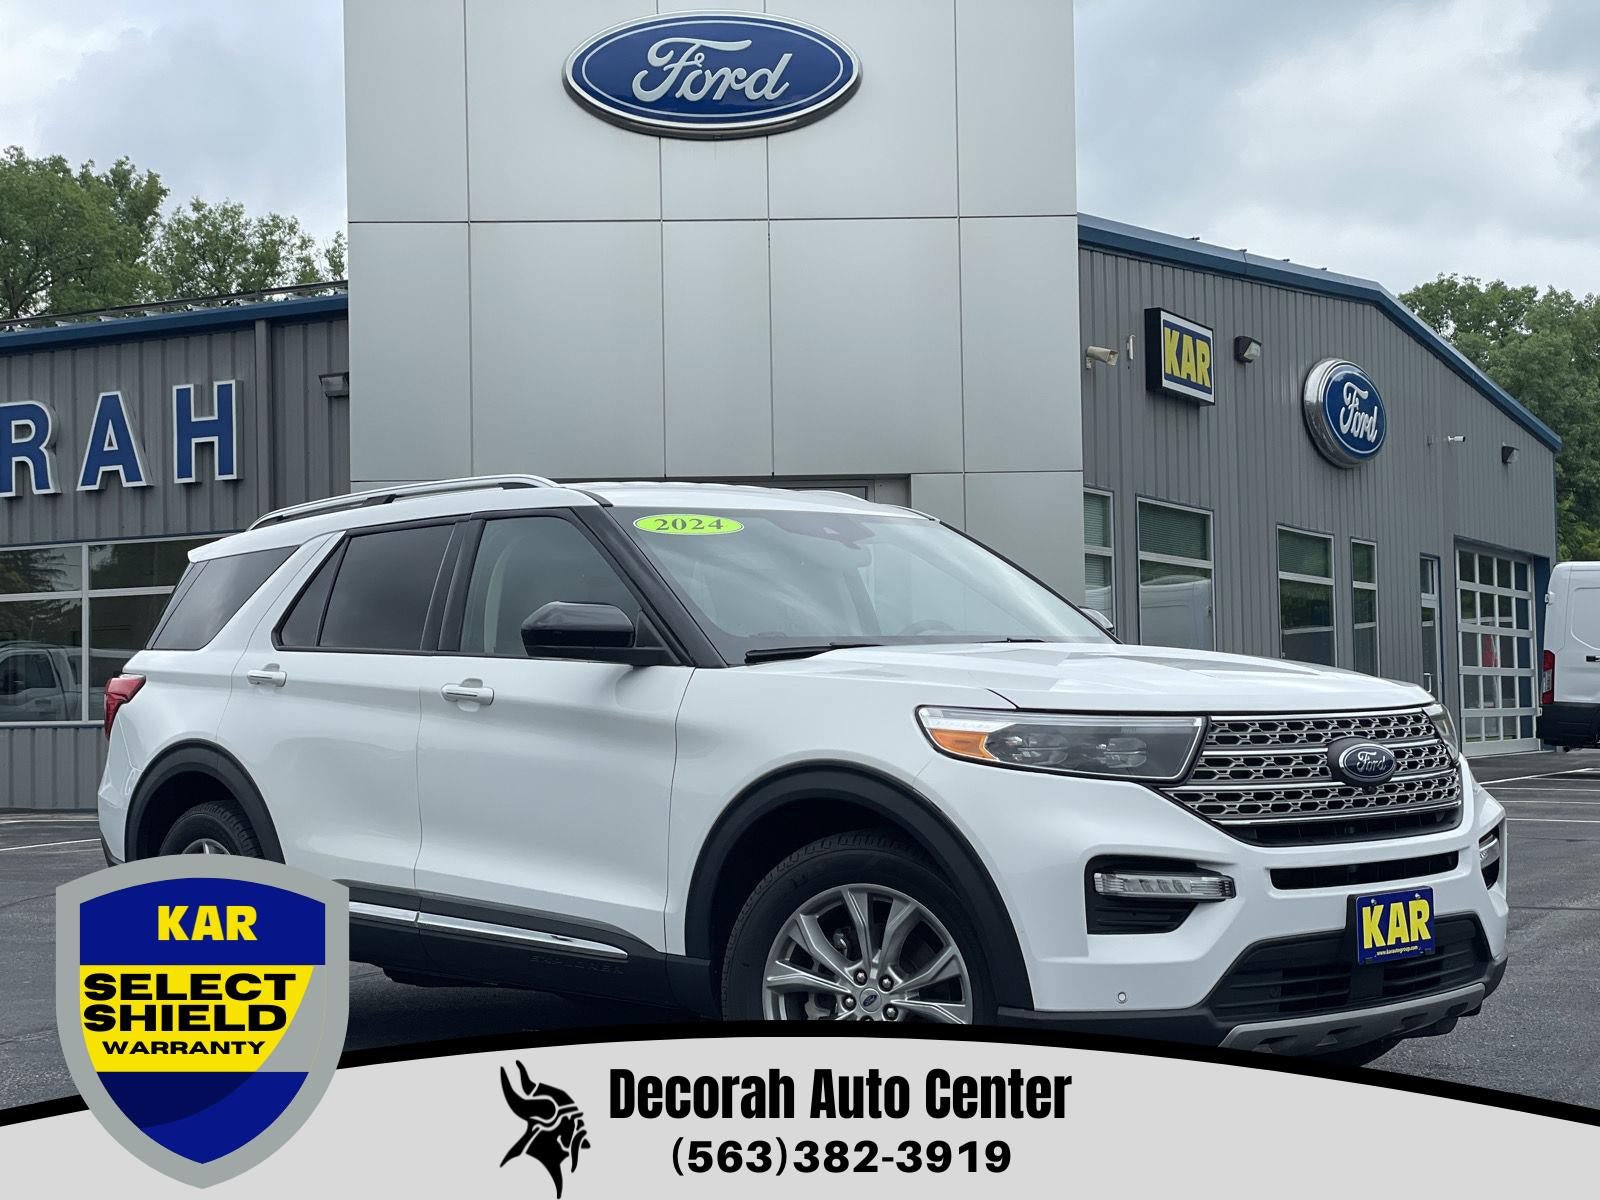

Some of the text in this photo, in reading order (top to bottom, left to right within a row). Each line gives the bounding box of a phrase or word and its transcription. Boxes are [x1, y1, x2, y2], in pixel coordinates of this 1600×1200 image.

[632, 37, 793, 102] Ford
[1163, 326, 1212, 389] KAR
[0, 379, 237, 498] RAH
[1339, 381, 1378, 443] Ford
[654, 518, 724, 531] 2024
[1356, 750, 1387, 773] Ford
[1362, 899, 1432, 949] KAR
